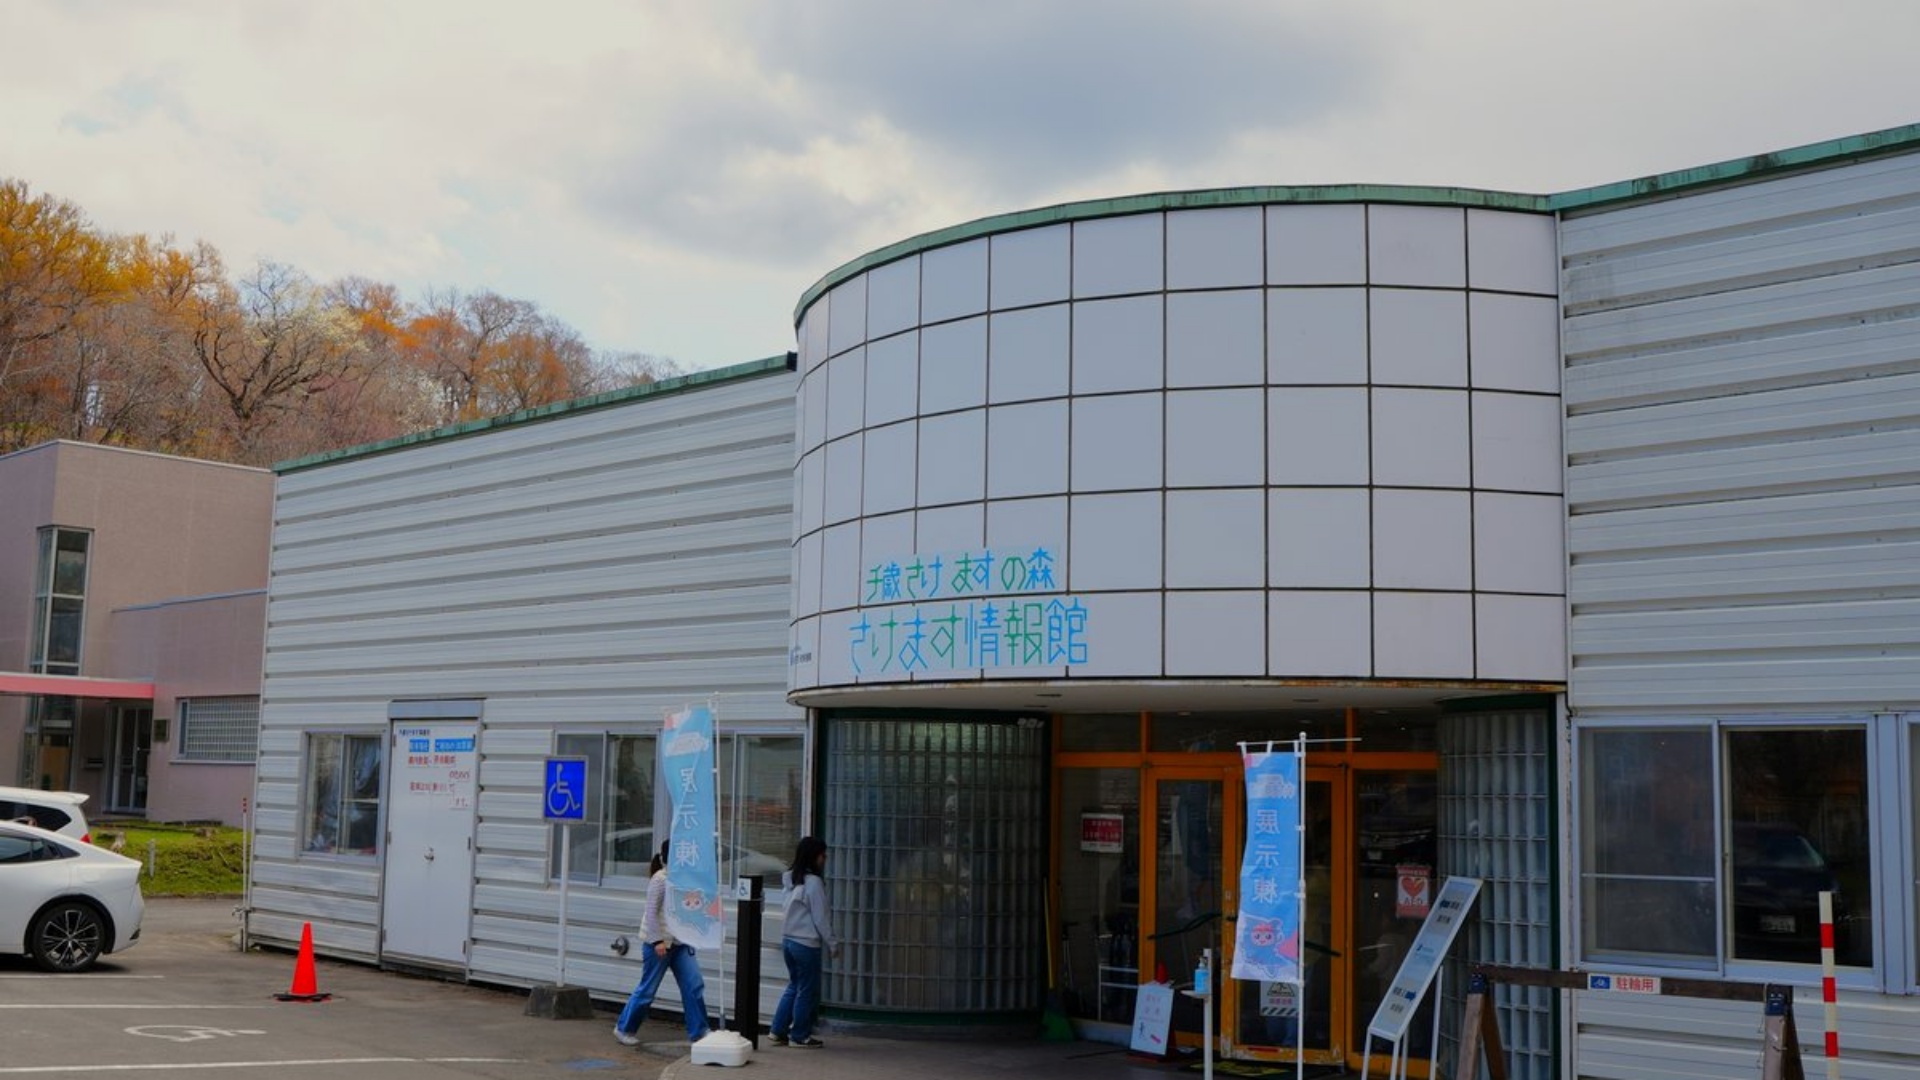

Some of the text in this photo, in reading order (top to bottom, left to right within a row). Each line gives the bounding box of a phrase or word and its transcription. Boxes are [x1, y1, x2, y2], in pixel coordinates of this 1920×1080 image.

[849, 597, 1088, 673] さけます情報館
[1616, 976, 1654, 992] 駐輪用
